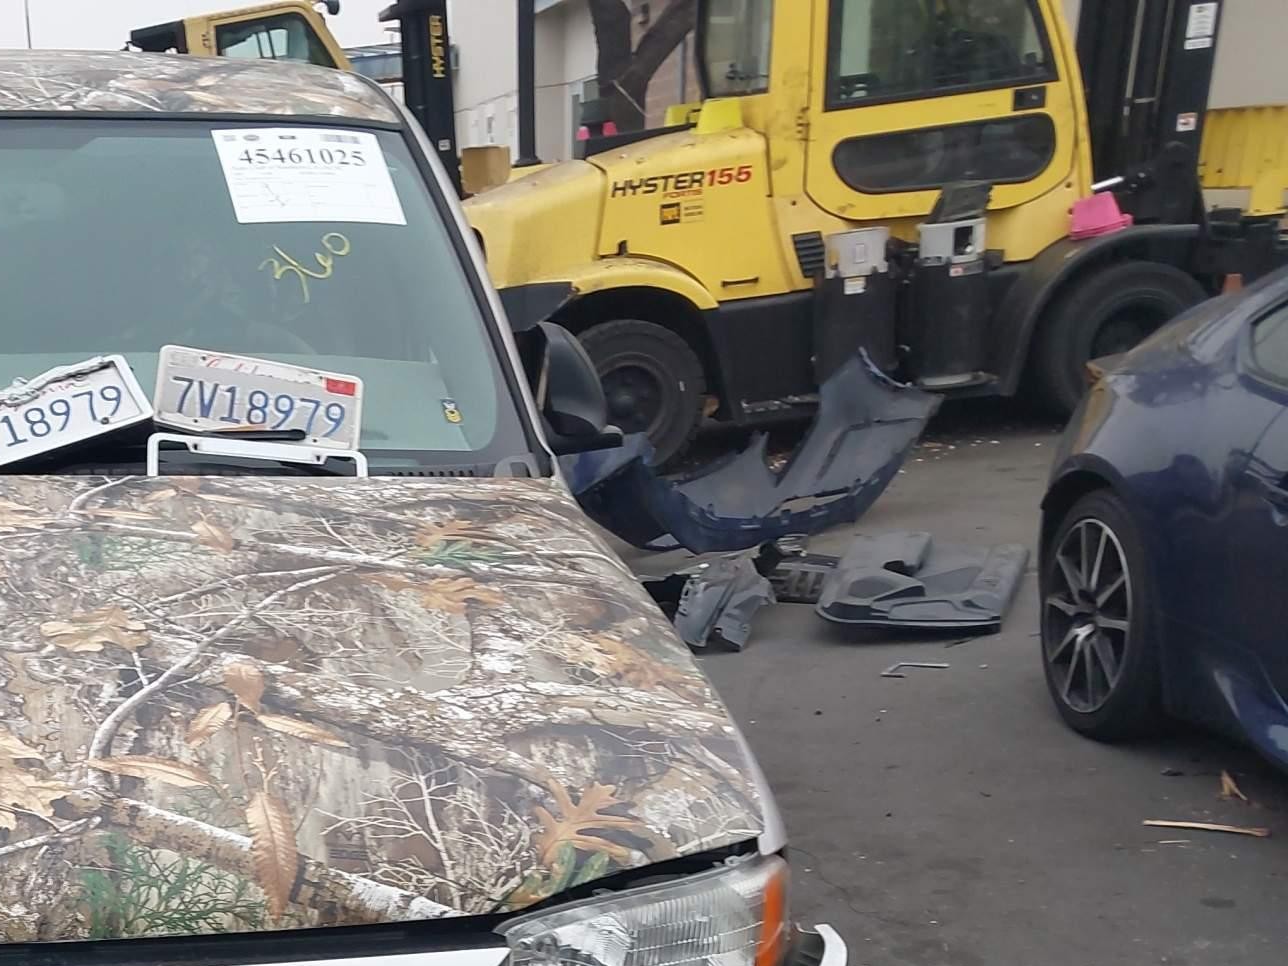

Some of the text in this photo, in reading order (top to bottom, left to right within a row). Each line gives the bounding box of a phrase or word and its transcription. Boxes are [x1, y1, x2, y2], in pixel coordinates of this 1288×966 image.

[238, 148, 367, 167] 45461025
[611, 165, 753, 198] HYSTER 155
[172, 375, 346, 438] 7V18979
